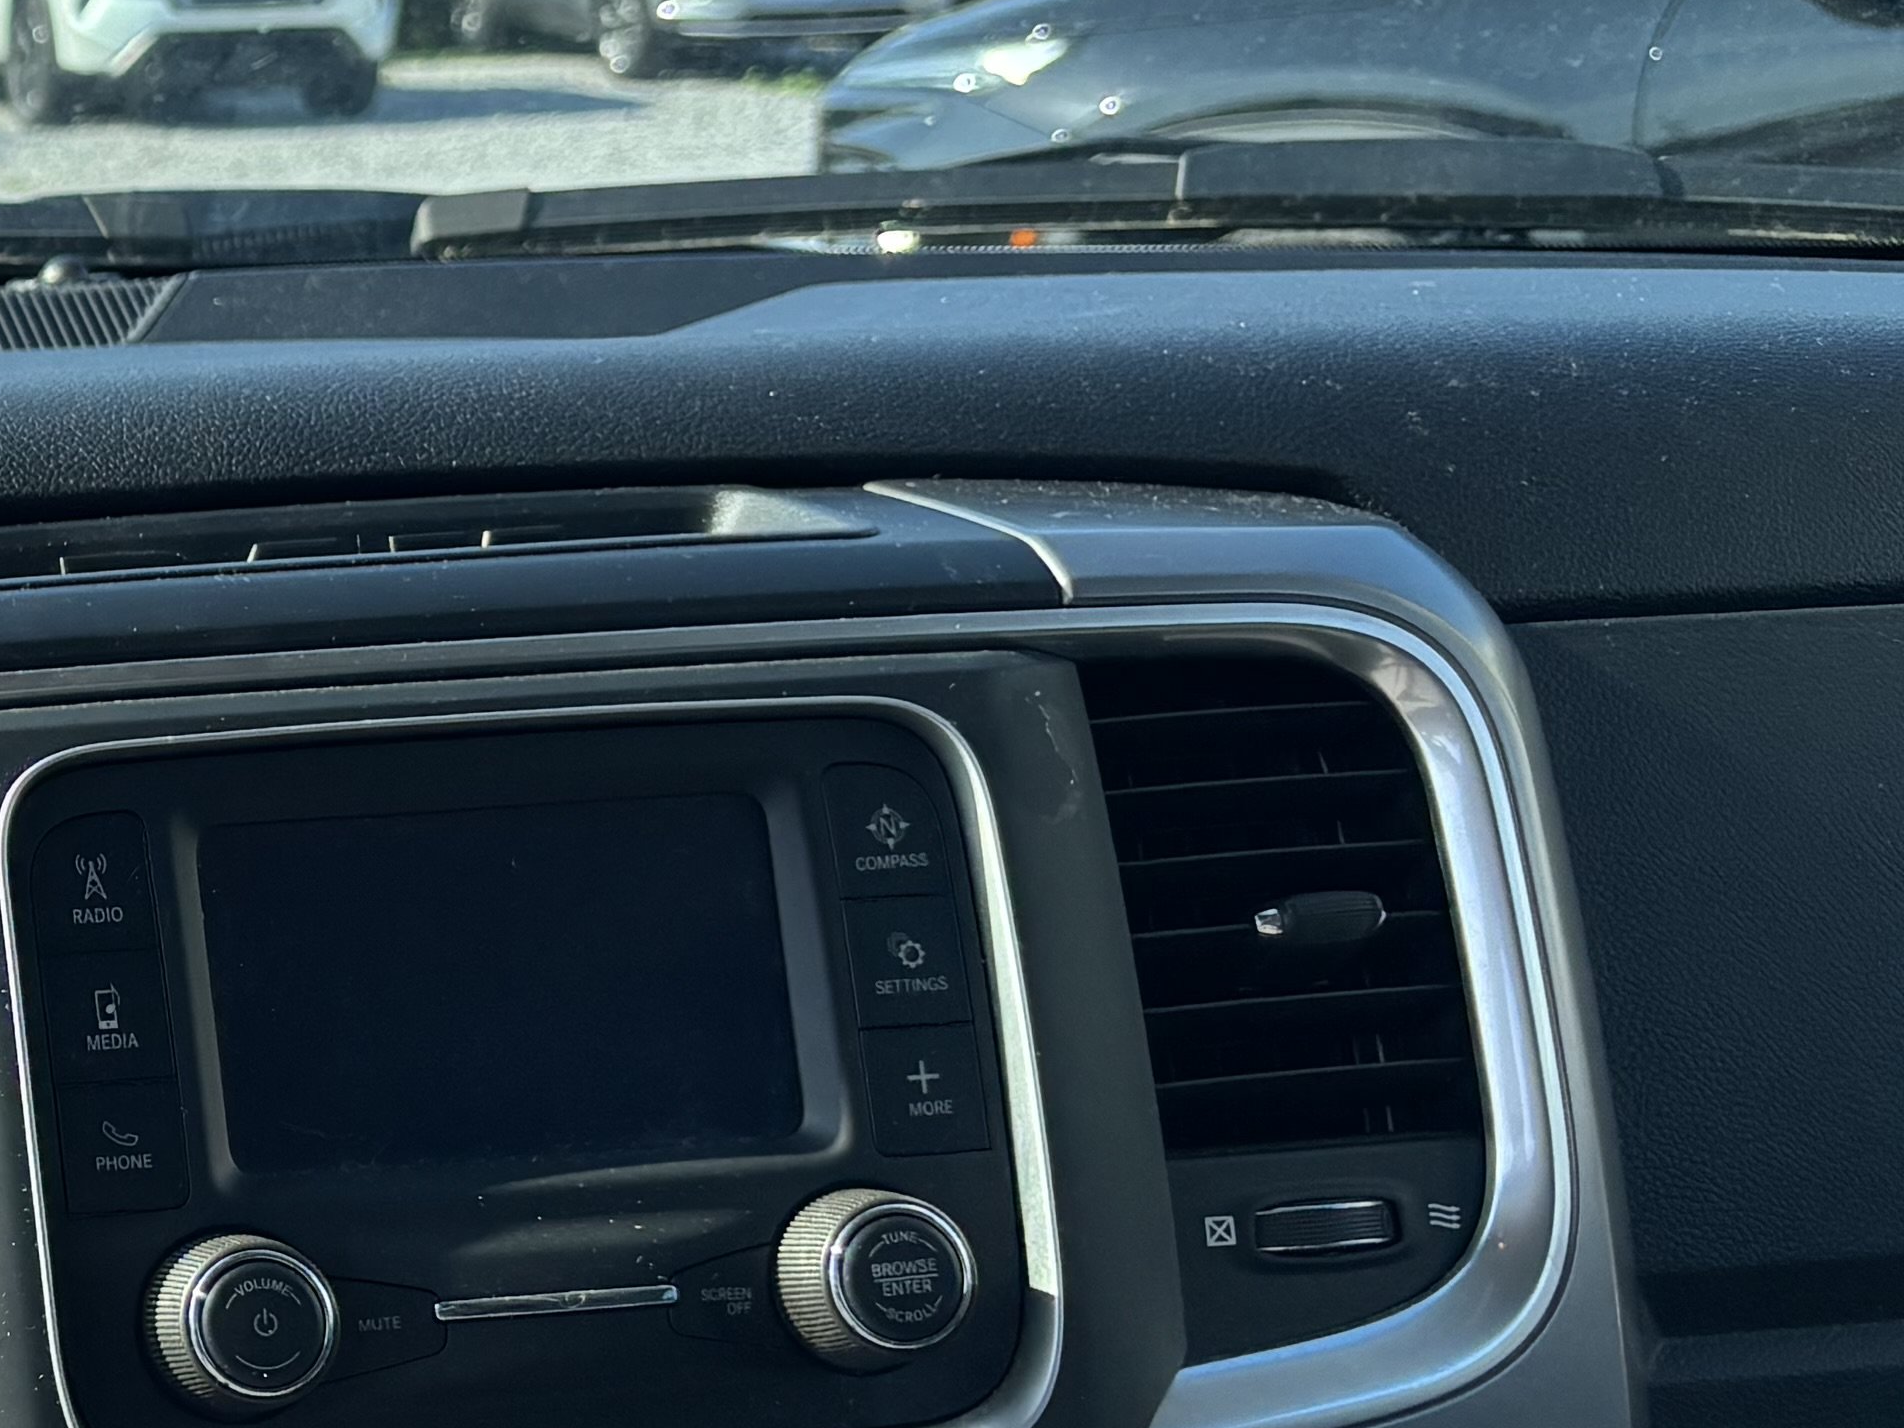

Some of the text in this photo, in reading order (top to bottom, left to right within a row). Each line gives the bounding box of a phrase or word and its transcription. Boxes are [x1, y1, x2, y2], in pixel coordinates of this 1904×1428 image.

[855, 852, 929, 871] COMPASS
[72, 907, 124, 924] RADIO
[875, 975, 949, 995] SETTINGS
[86, 1032, 139, 1052] MEDIA
[909, 1100, 954, 1117] MORE
[95, 1154, 153, 1171] PHONE
[881, 1231, 919, 1246] TUNE
[871, 1258, 938, 1278] BROWSE
[235, 1277, 292, 1297] VOLUME
[701, 1286, 752, 1302] SCREEN
[882, 1279, 934, 1298] ENTER
[726, 1302, 752, 1316] OFF
[886, 1303, 938, 1323] SCROLL
[358, 1316, 402, 1332] MUTE
